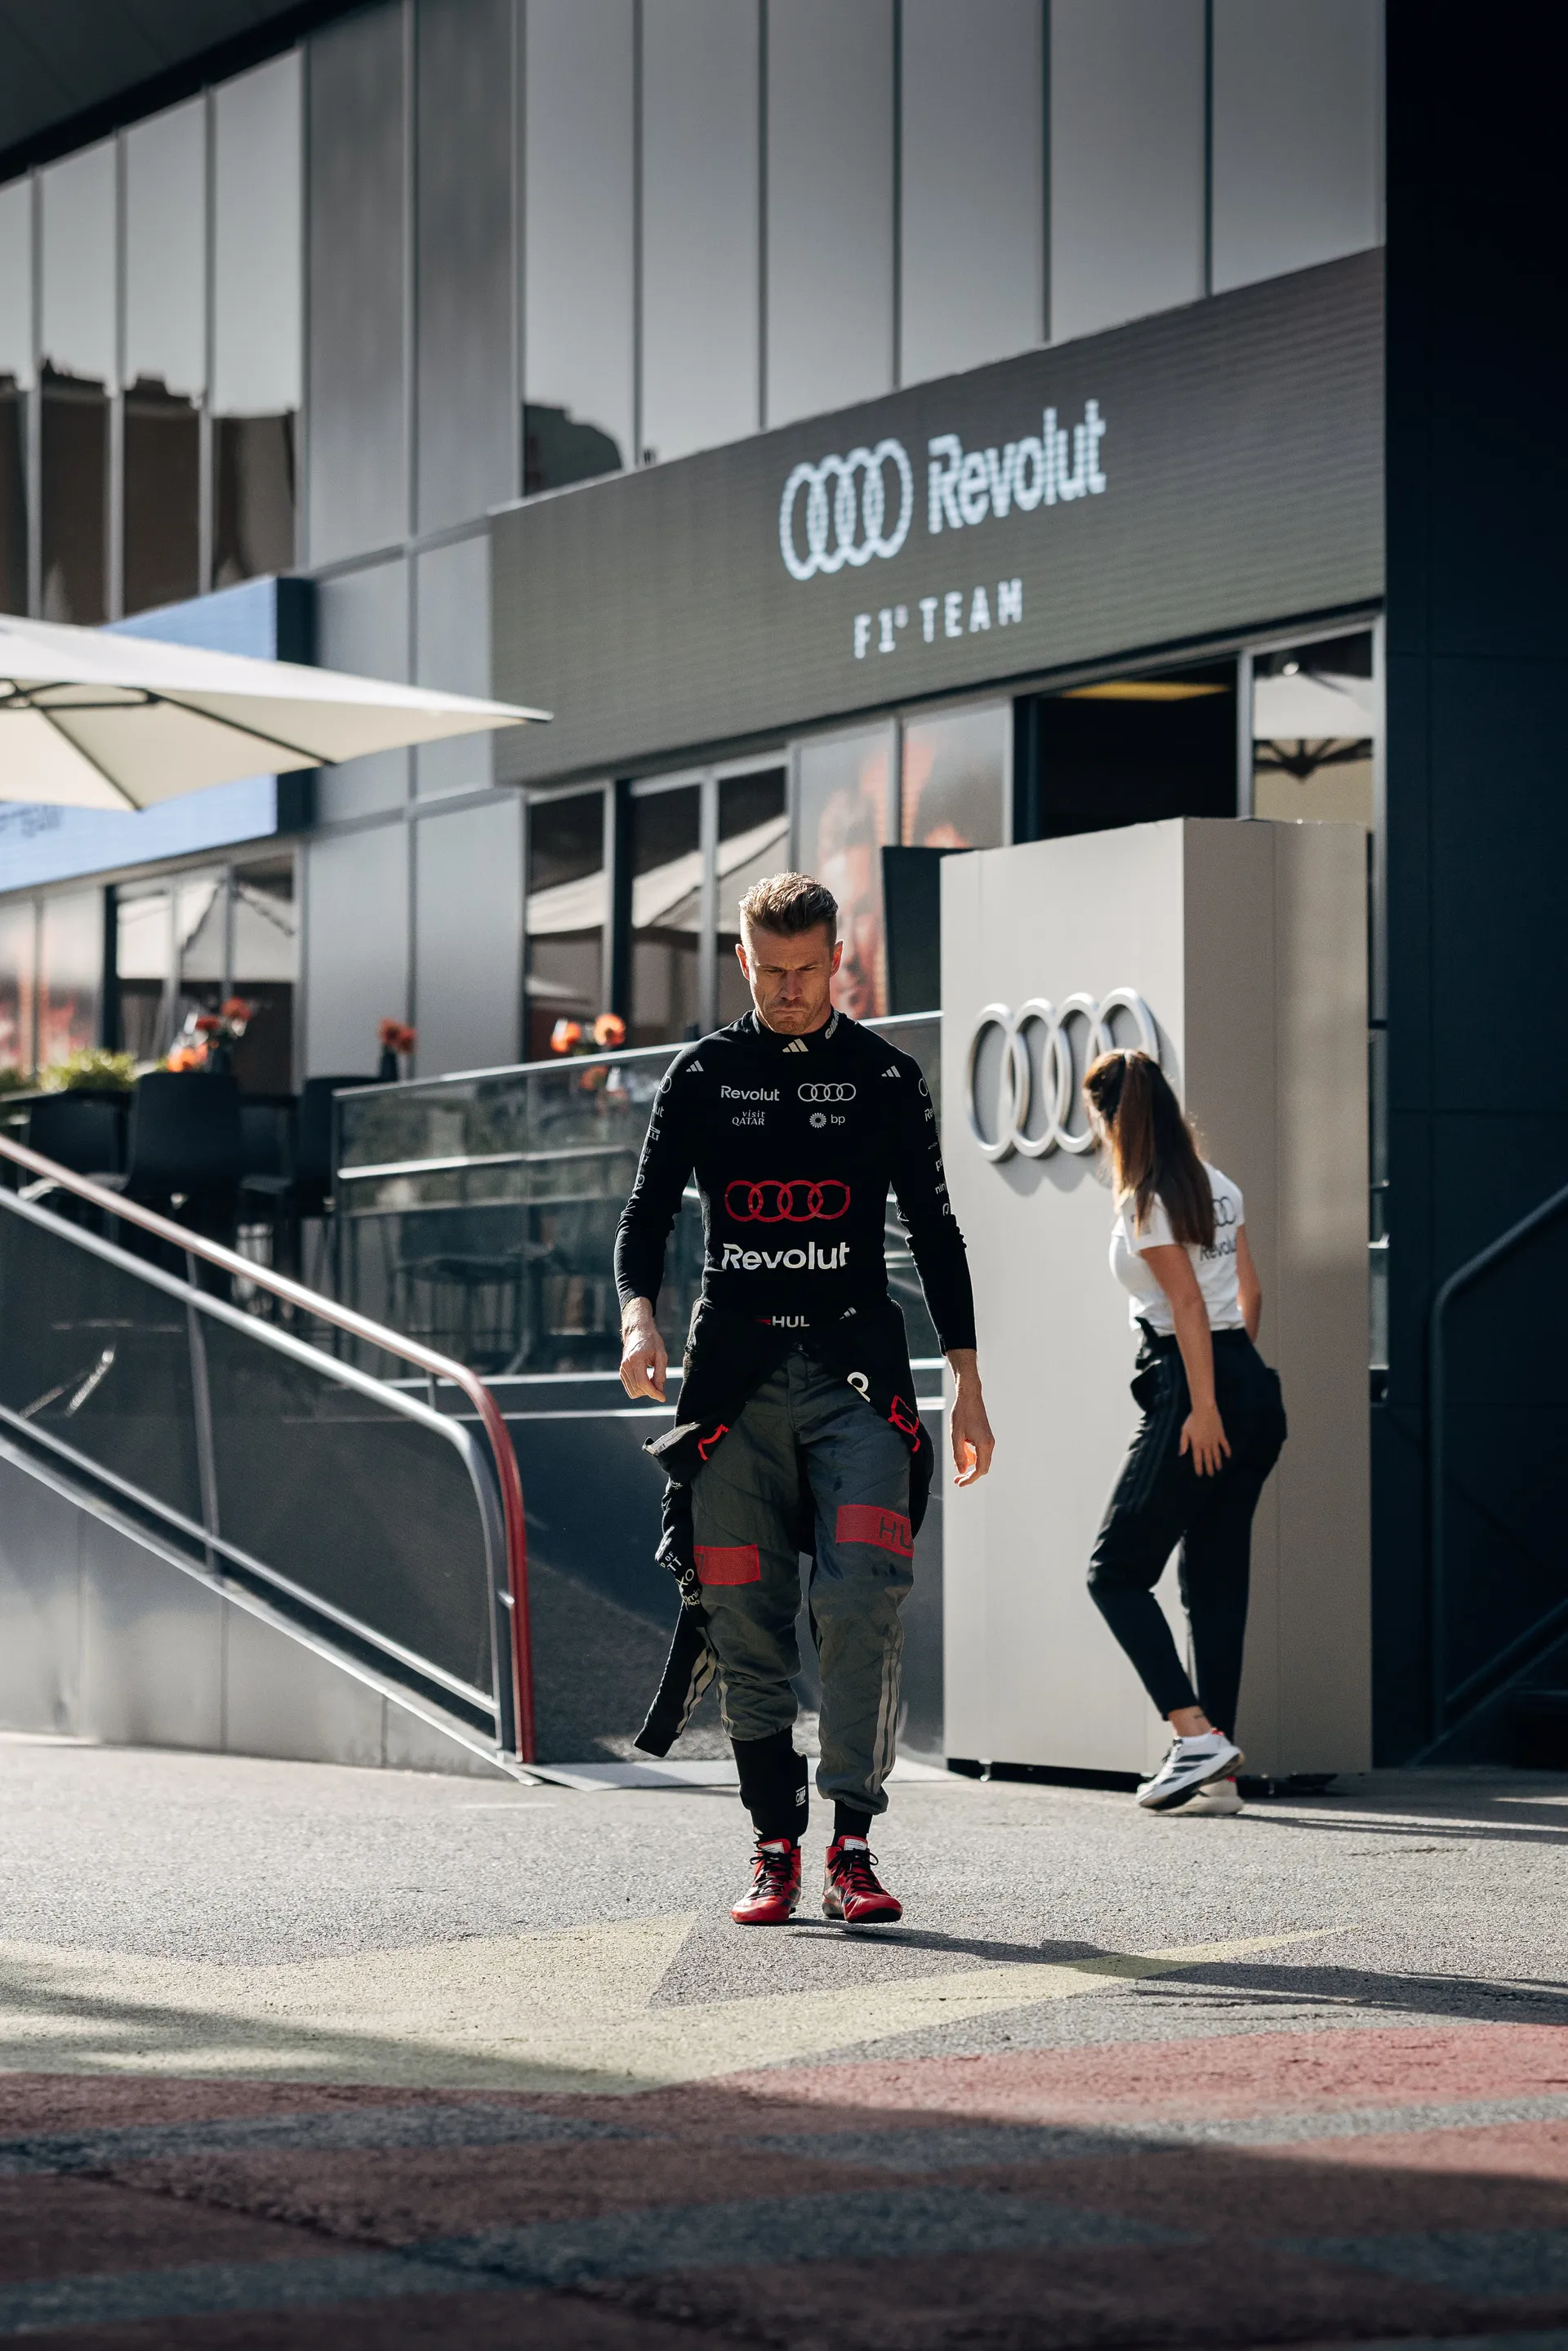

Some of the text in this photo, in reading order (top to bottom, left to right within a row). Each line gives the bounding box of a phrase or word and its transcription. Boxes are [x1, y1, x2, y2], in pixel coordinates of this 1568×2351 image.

[929, 399, 1107, 534] Revolut
[919, 577, 1022, 643] TEAM
[721, 1085, 780, 1101] Revolut
[732, 1116, 765, 1126] QATAR
[742, 1110, 766, 1118] visit
[831, 1114, 845, 1125] bp
[721, 1241, 850, 1270] Revolut
[772, 1316, 810, 1328] HUL
[880, 1516, 912, 1550] HU
